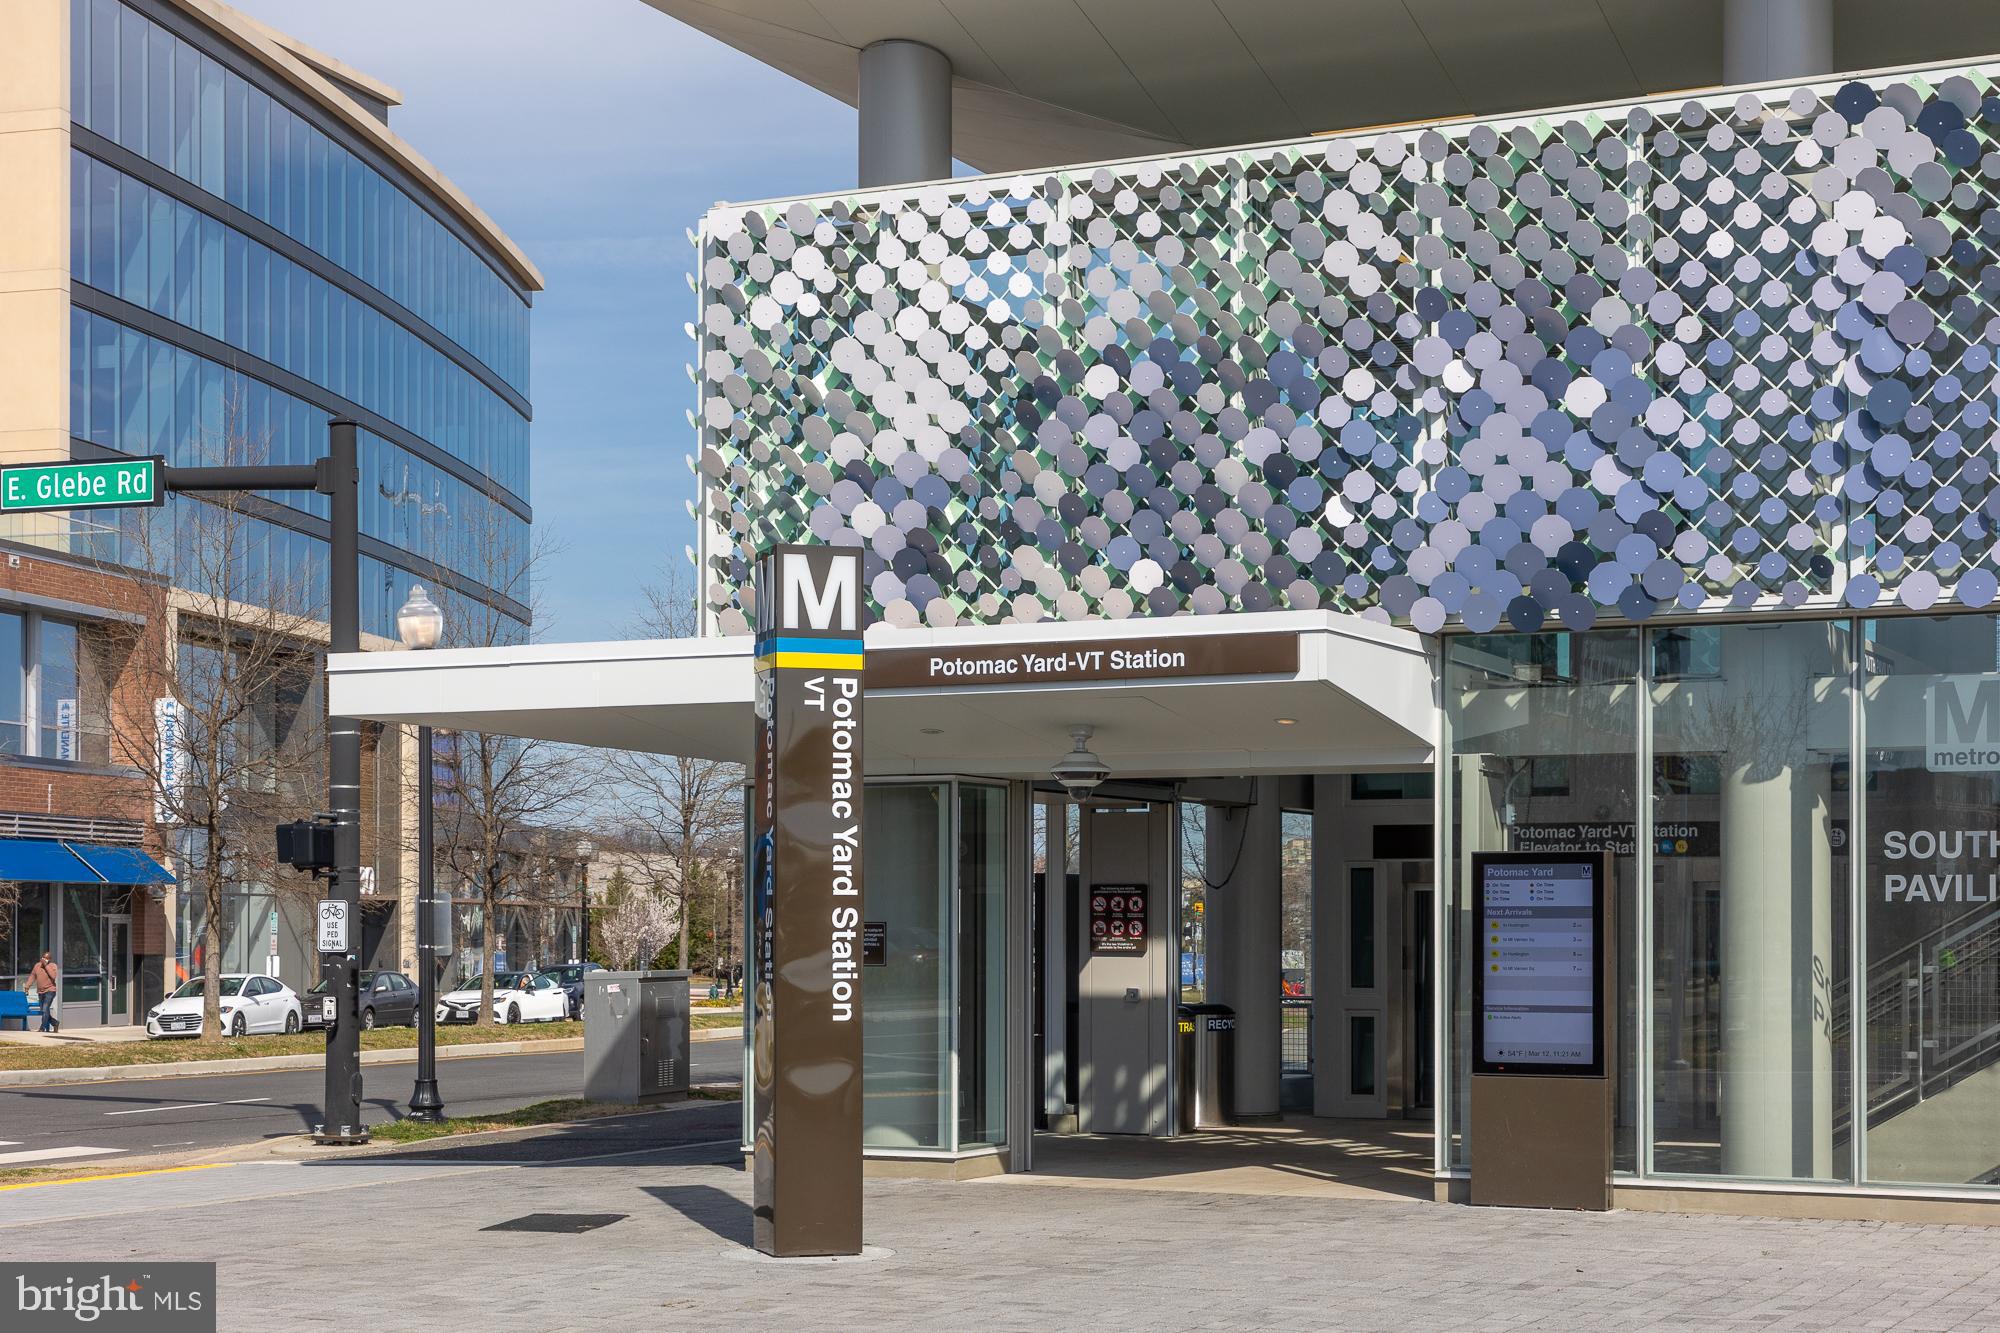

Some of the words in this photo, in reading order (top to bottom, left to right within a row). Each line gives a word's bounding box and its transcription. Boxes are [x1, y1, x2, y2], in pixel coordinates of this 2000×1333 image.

[8, 477, 26, 500] E.
[37, 471, 106, 499] Glebe
[117, 468, 147, 494] Rd
[784, 553, 857, 631] M
[929, 656, 1018, 676] Potomac
[1021, 651, 1104, 672] Yard-VT
[1110, 649, 1185, 670] Station
[804, 676, 825, 711] VT
[1934, 680, 2000, 744] M
[765, 677, 775, 818] Potomac
[832, 678, 858, 818] Potomac
[1934, 748, 2000, 766] metro
[1513, 825, 1576, 839] Potomac
[1653, 824, 1699, 837] tation
[1605, 841, 1660, 853] Statn
[765, 825, 774, 895] Yard
[832, 825, 858, 896] Yard
[1487, 868, 1529, 877] Potomac
[1532, 868, 1553, 877] Yard
[1885, 874, 1997, 902] PAVILI
[322, 940, 343, 948] SIGNAL
[831, 907, 858, 1022] Station
